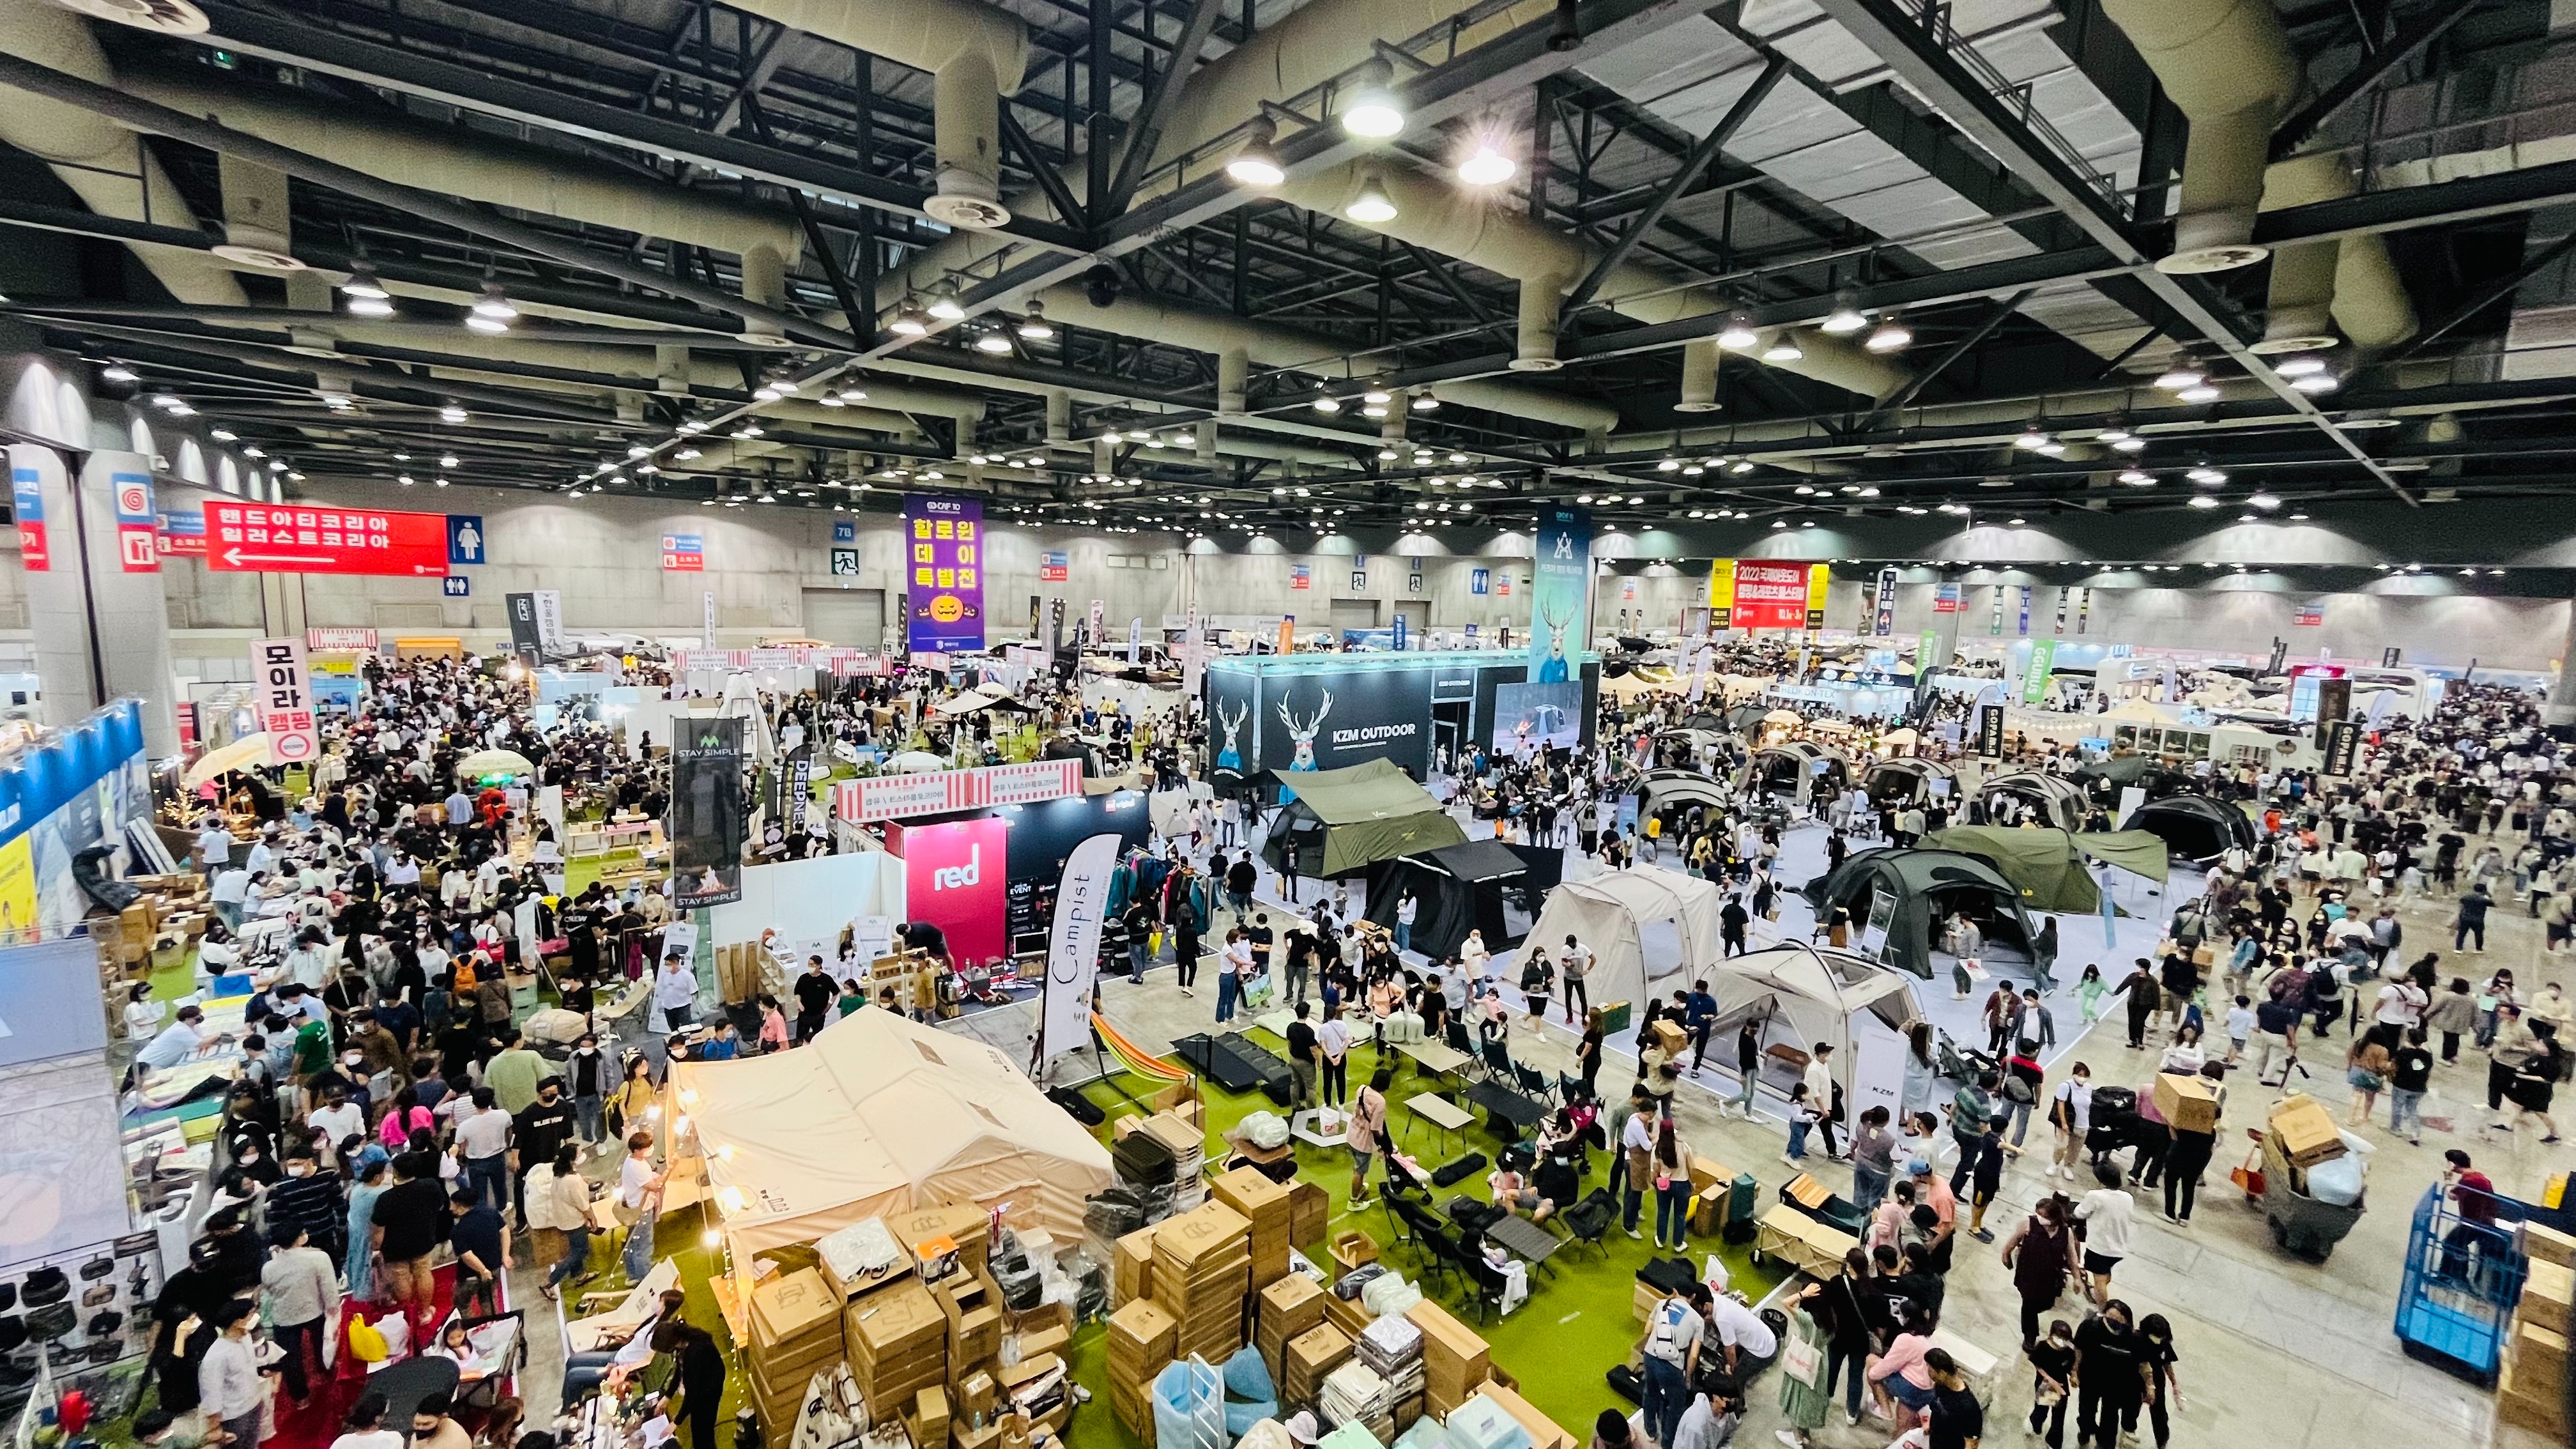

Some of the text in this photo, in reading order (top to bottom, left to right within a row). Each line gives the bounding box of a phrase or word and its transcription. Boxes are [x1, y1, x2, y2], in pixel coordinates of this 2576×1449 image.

[218, 509, 388, 532] 핸드아티코리아
[913, 518, 975, 541] 할로윈
[220, 527, 390, 549] 일러스트코리아
[915, 567, 976, 588] 특별전
[1738, 566, 1760, 581] 2022
[268, 711, 312, 732] 캠핑
[1333, 723, 1416, 744] KZM OUTDOOR
[678, 747, 739, 758] STAY SIMPLE
[934, 843, 979, 892] red
[678, 893, 737, 906] STAY SIMPLE
[1010, 885, 1032, 895] EVENT
[1052, 874, 1092, 984] Campist
[1872, 1086, 1894, 1097] KZM
